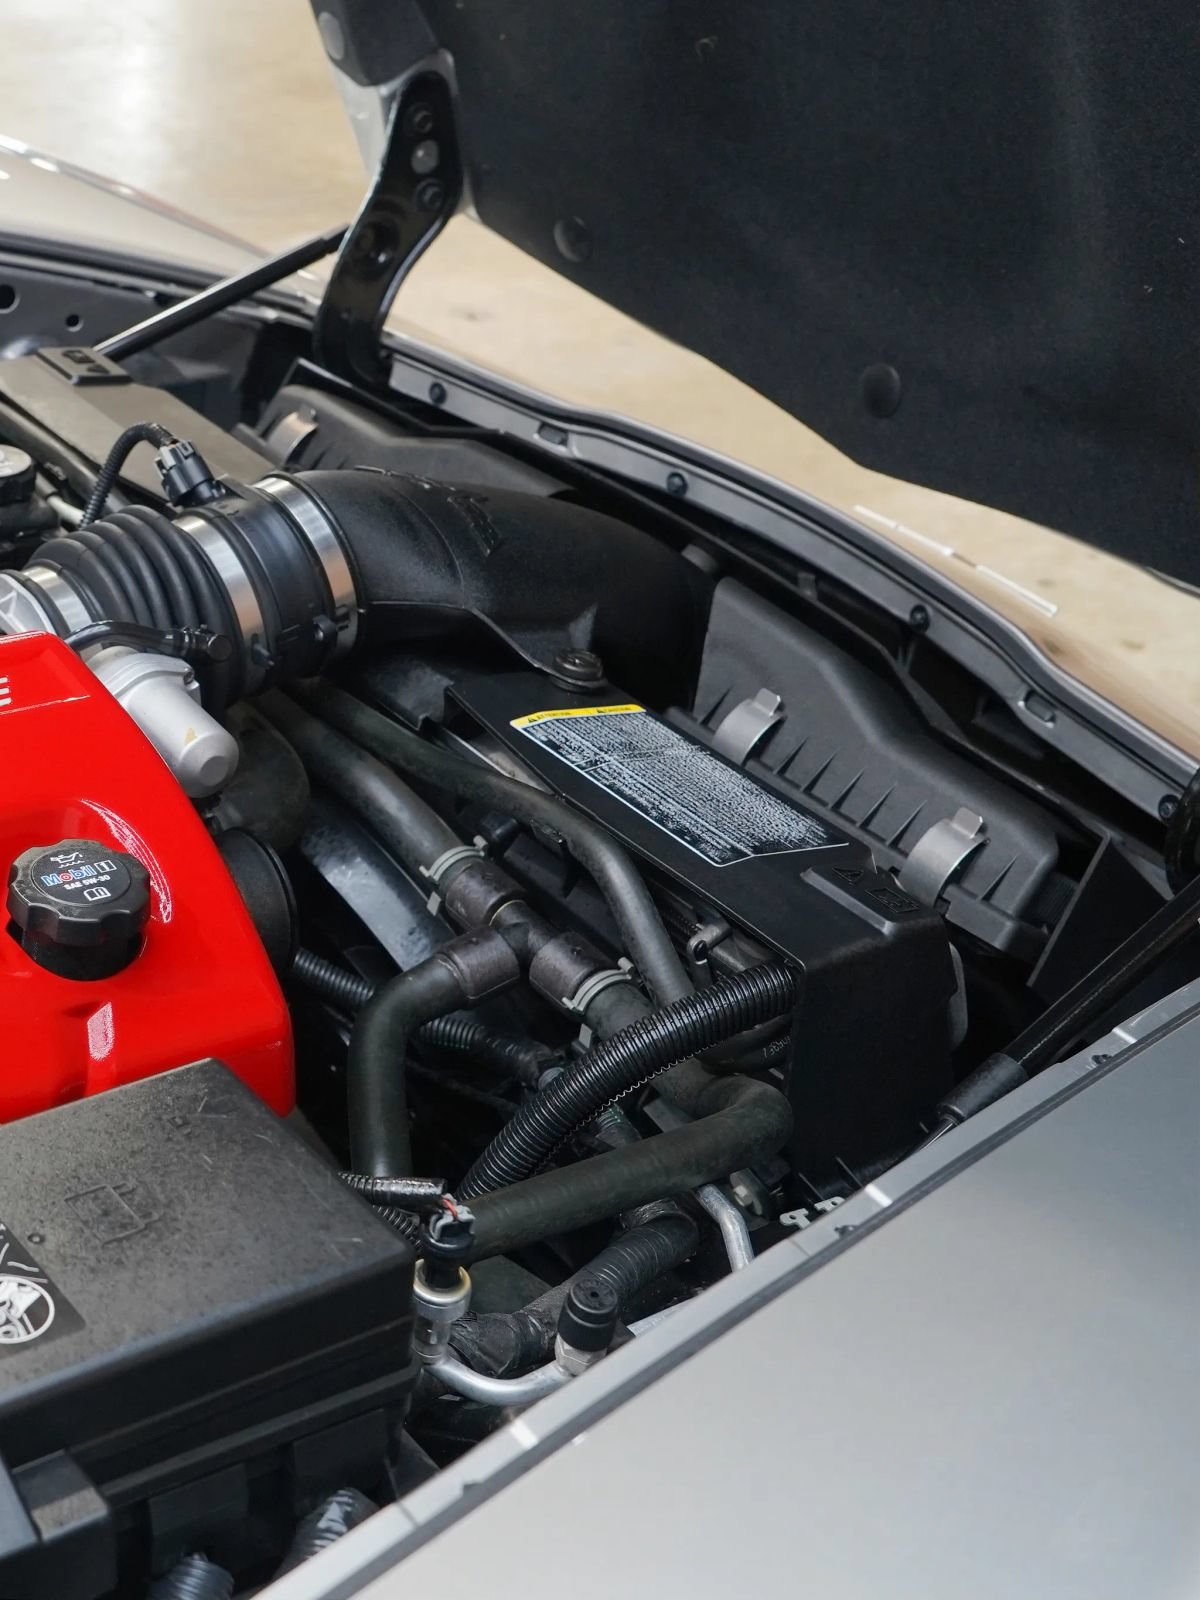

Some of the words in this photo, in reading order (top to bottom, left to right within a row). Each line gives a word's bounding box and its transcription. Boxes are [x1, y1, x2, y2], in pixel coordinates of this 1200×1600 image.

[41, 864, 97, 886] Mobil
[63, 880, 83, 890] SAE
[84, 875, 111, 886] 5W-30
